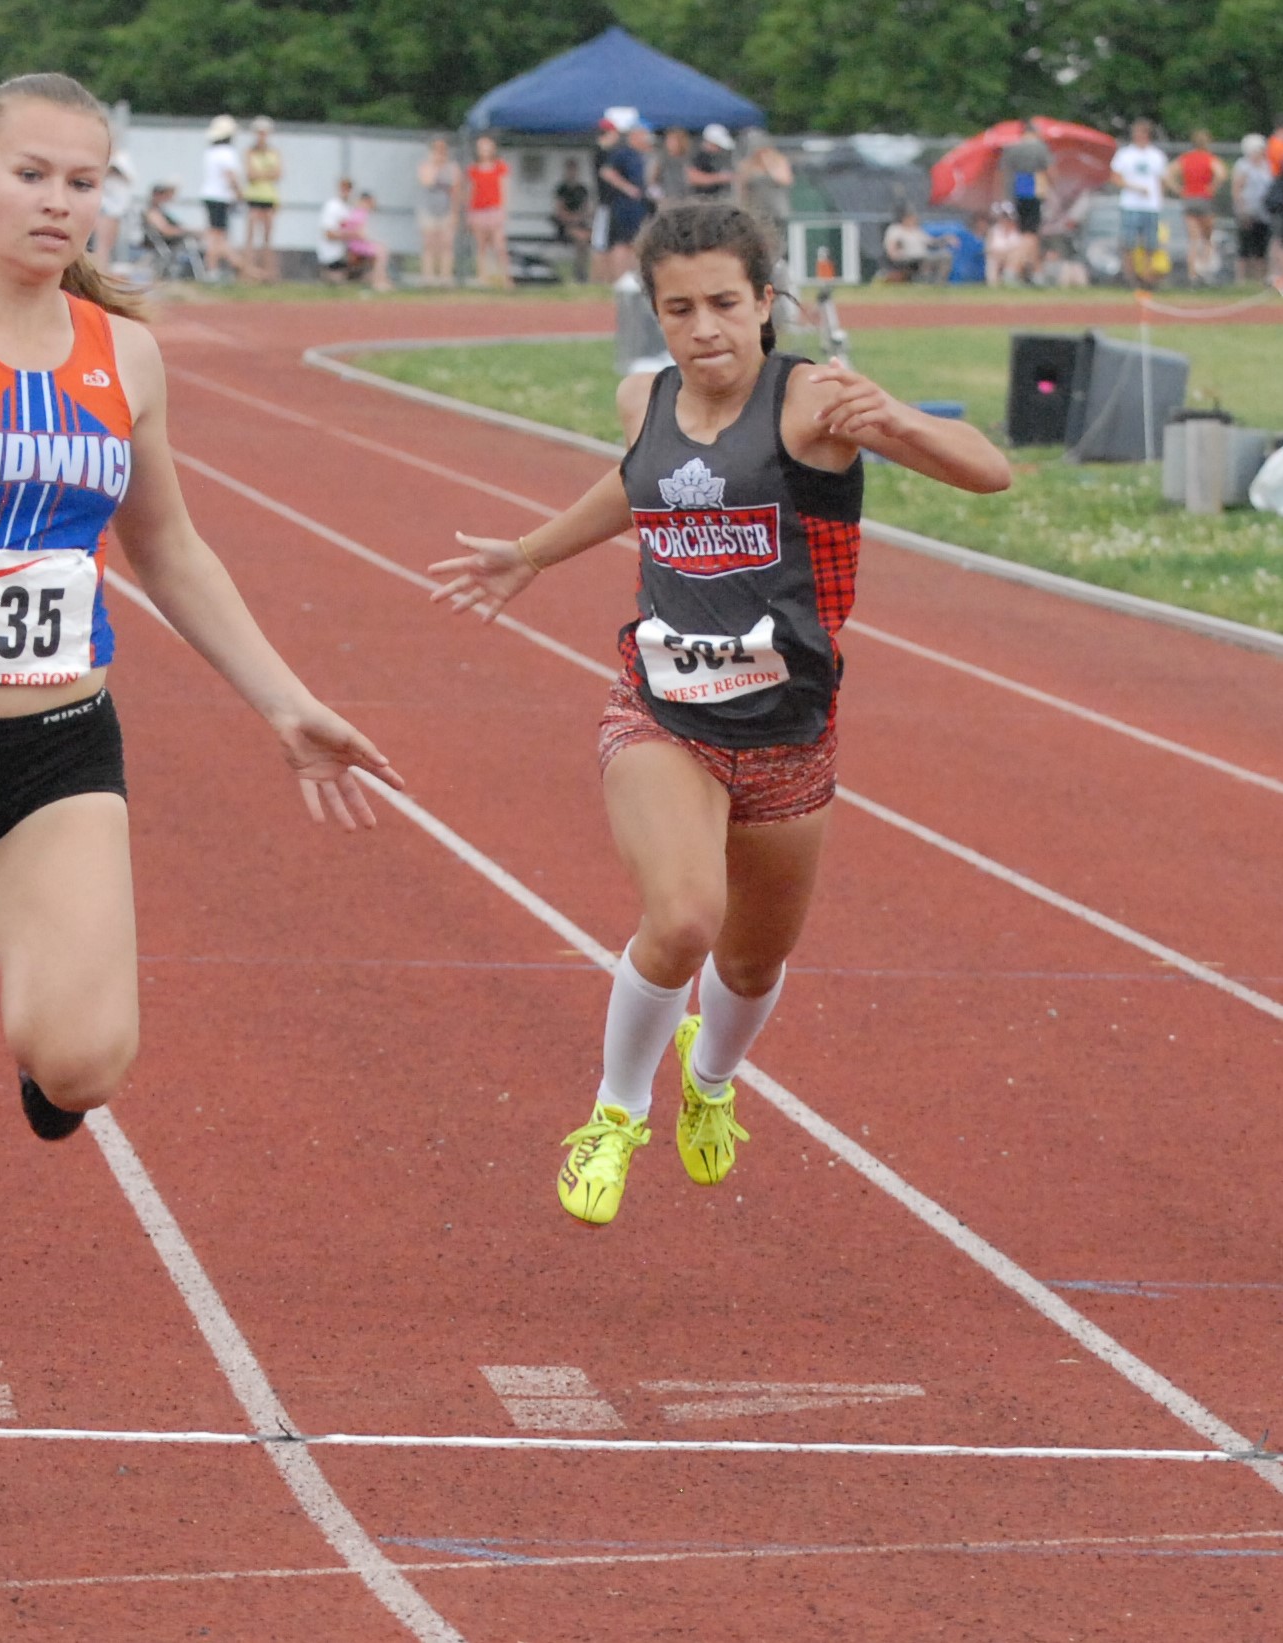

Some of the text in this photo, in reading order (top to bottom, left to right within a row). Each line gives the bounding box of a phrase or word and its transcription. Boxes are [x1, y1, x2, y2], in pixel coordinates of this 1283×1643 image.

[668, 514, 731, 527] LORD
[640, 524, 772, 557] DORCHESTER
[0, 671, 80, 687] REGION
[664, 672, 779, 702] WEST REGION
